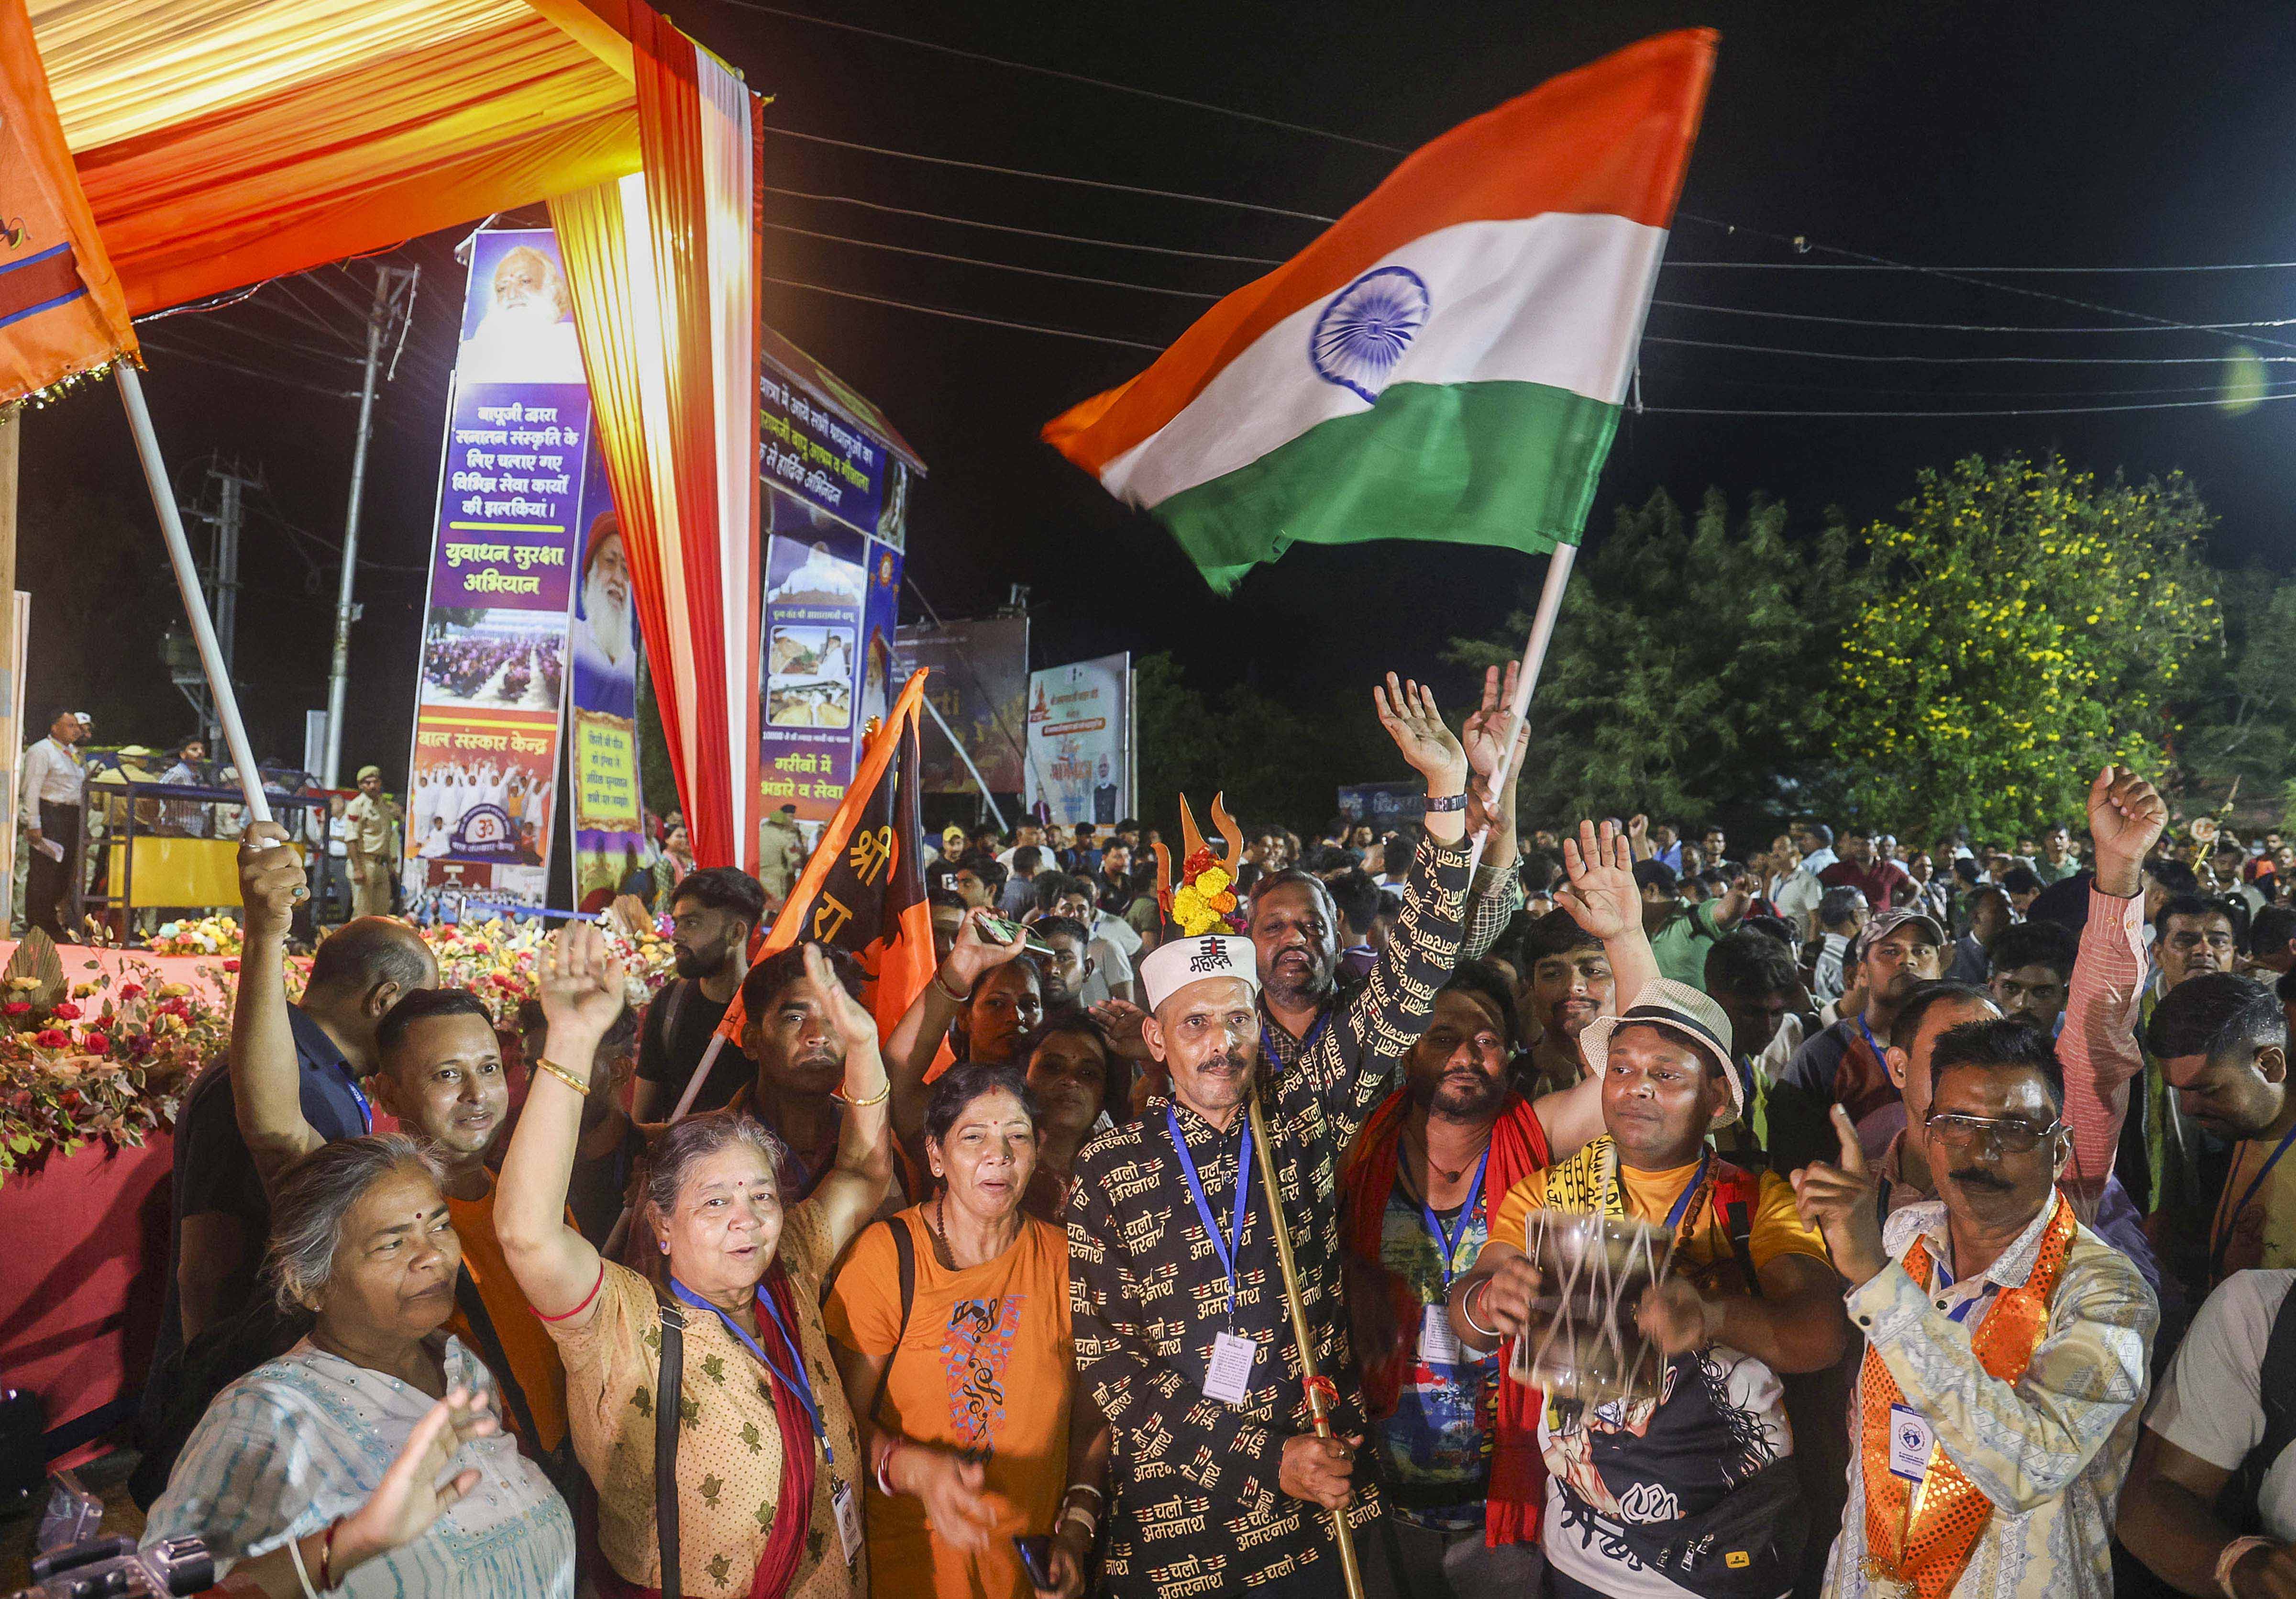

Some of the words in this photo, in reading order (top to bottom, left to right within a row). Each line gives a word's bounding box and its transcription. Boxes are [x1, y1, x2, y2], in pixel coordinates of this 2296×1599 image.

[478, 402, 523, 426] बापूजी
[455, 430, 508, 445] सनातन
[509, 426, 562, 451] संस्कृति
[563, 426, 580, 447] के
[466, 448, 496, 470] लिए
[497, 454, 537, 472] चलाए
[539, 455, 563, 472] गए
[499, 472, 530, 493] सेवा
[531, 474, 570, 494] कार्यों
[462, 495, 483, 516] की
[445, 543, 511, 567] युवाधन
[513, 545, 565, 570] सुरक्षा
[463, 567, 540, 595] अभियान
[418, 731, 452, 748] बाल
[454, 727, 508, 752] संस्कार
[510, 730, 549, 756] केन्द्र
[774, 752, 817, 775] गरीबों
[819, 754, 832, 775] में
[798, 783, 811, 798] व
[813, 779, 845, 800] सेवा
[475, 819, 494, 838] ॐ
[850, 825, 892, 886] श्री
[814, 891, 853, 944] रा
[1082, 1132, 1142, 1162] अमरनाथ
[1110, 1160, 1139, 1182] चलो
[1126, 1210, 1153, 1236] चलो
[1074, 1334, 1101, 1355] चलो
[1153, 1494, 1183, 1520] चलो
[1142, 1514, 1206, 1543] अमरनाथ
[1236, 1513, 1301, 1552] अमरनाथ
[1169, 1554, 1200, 1579] चलो
[1264, 1554, 1296, 1580] चलो
